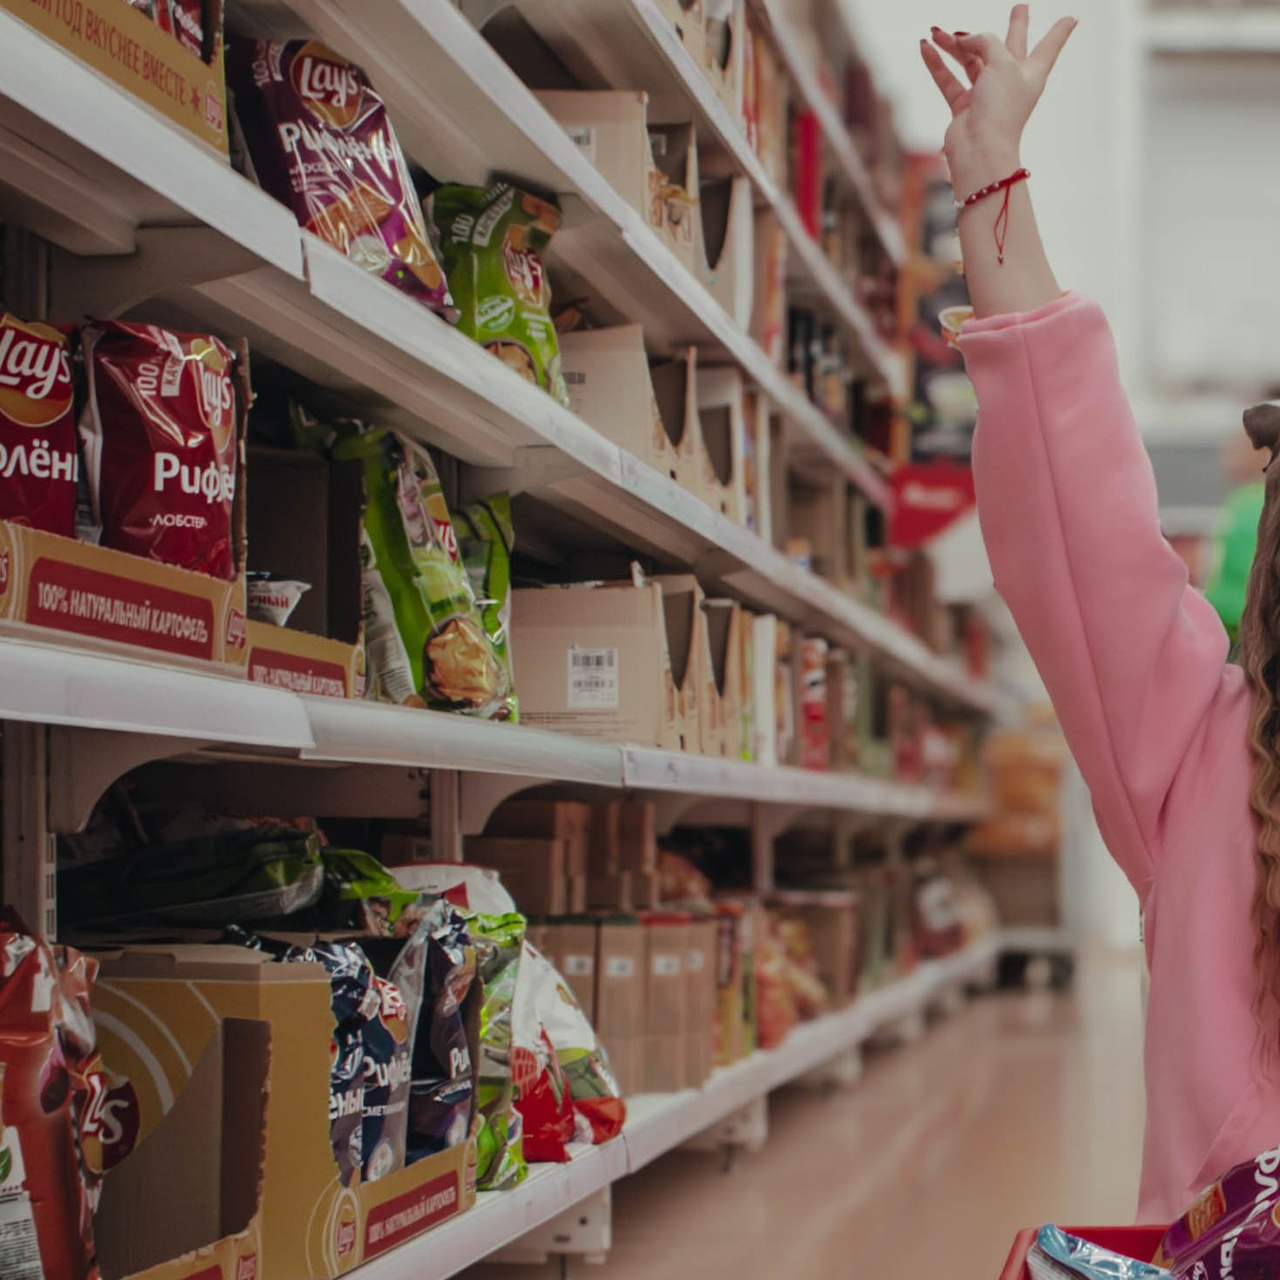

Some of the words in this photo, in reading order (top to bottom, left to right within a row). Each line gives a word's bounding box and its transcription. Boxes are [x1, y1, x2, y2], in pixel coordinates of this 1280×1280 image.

[84, 4, 141, 75] ВКУСНЕЕ
[141, 46, 186, 107] ВМЕСТЕ
[301, 56, 359, 108] Lay's
[0, 328, 72, 400] Lay's
[37, 581, 69, 614] 100%
[69, 589, 151, 631] НАТУРАЛЬНЫЙ
[151, 607, 208, 644] КАРТОФЕЛЬ
